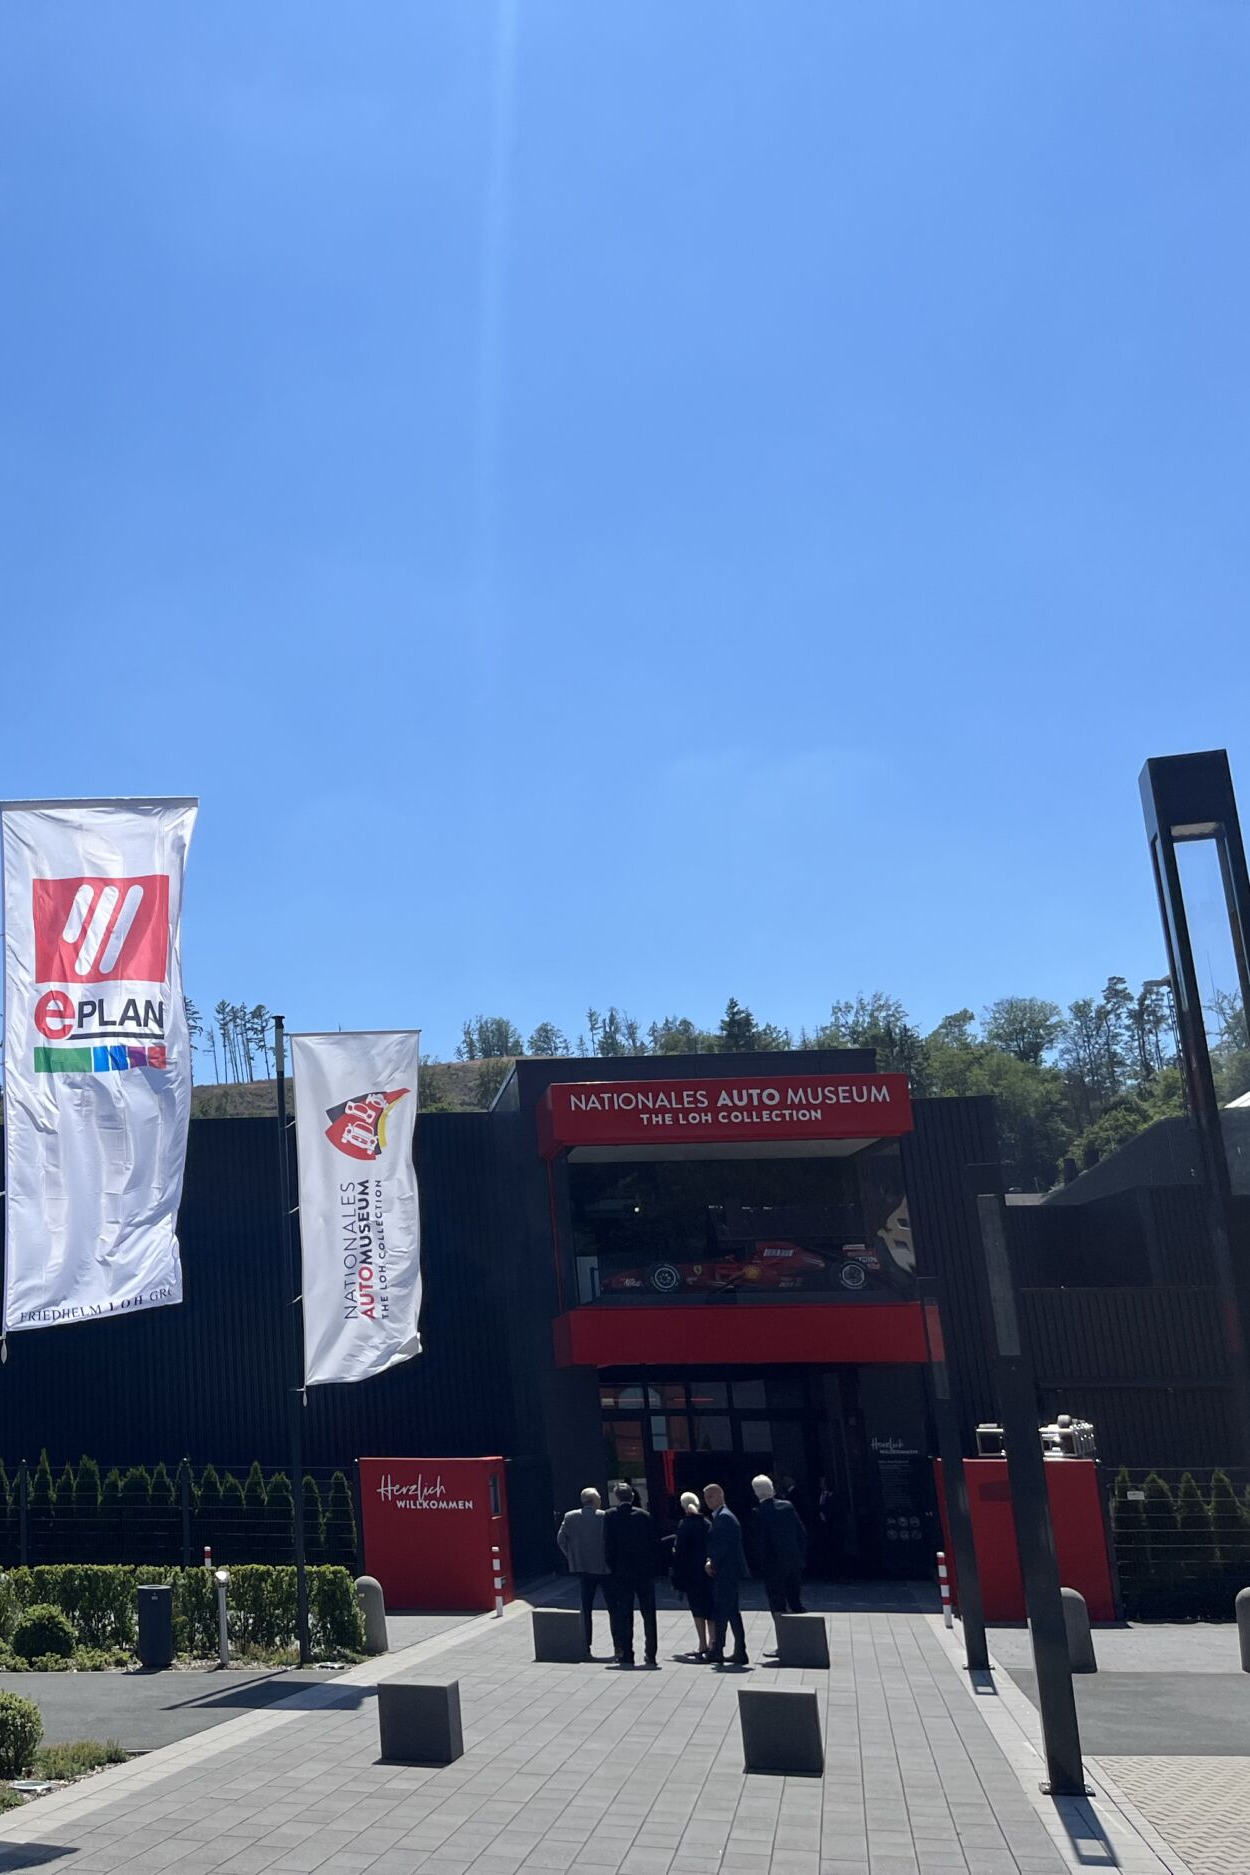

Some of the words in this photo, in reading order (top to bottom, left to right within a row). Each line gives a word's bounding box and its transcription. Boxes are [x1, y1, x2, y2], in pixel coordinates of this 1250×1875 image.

[570, 1090, 709, 1112] NATIONALES
[716, 1088, 781, 1108] AUTO
[786, 1085, 891, 1105] MUSEUM
[640, 1113, 675, 1126] THE
[679, 1112, 712, 1124] LOH
[718, 1109, 822, 1123] COLLECTION
[375, 1180, 385, 1260] COLLECTION
[340, 1181, 357, 1320] NATIONALES
[357, 1179, 376, 1320] AUTOMUSEUM
[379, 1265, 388, 1291] LOH
[20, 1304, 102, 1323] FRIEDHELM
[108, 1294, 143, 1312] LOH
[381, 1296, 390, 1320] THE
[376, 1473, 447, 1503] Herzlich
[396, 1500, 474, 1510] WILLKOMMEN
